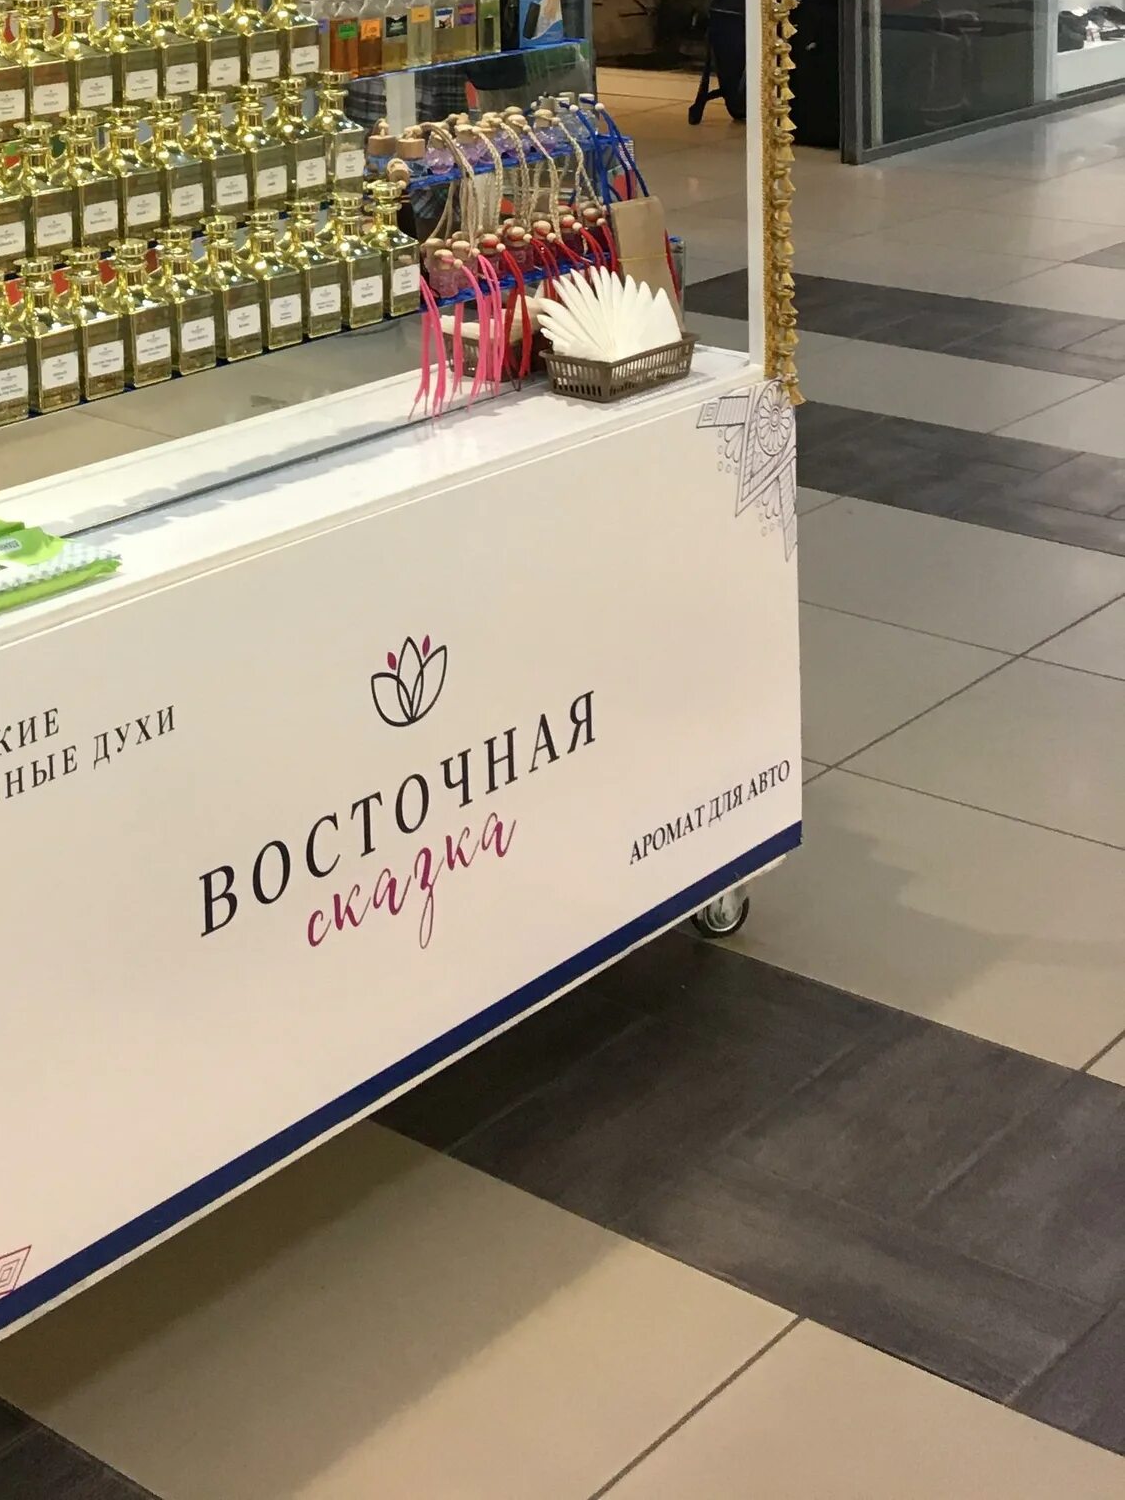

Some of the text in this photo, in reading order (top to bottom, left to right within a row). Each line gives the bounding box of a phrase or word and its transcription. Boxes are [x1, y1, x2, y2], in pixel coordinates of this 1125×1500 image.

[93, 705, 175, 770] ДУХИ
[198, 690, 596, 938] ВОСТОЧНАЯ
[629, 759, 791, 866] АРОМАТ ДЛЯ АВТО
[307, 811, 517, 950] сказка
